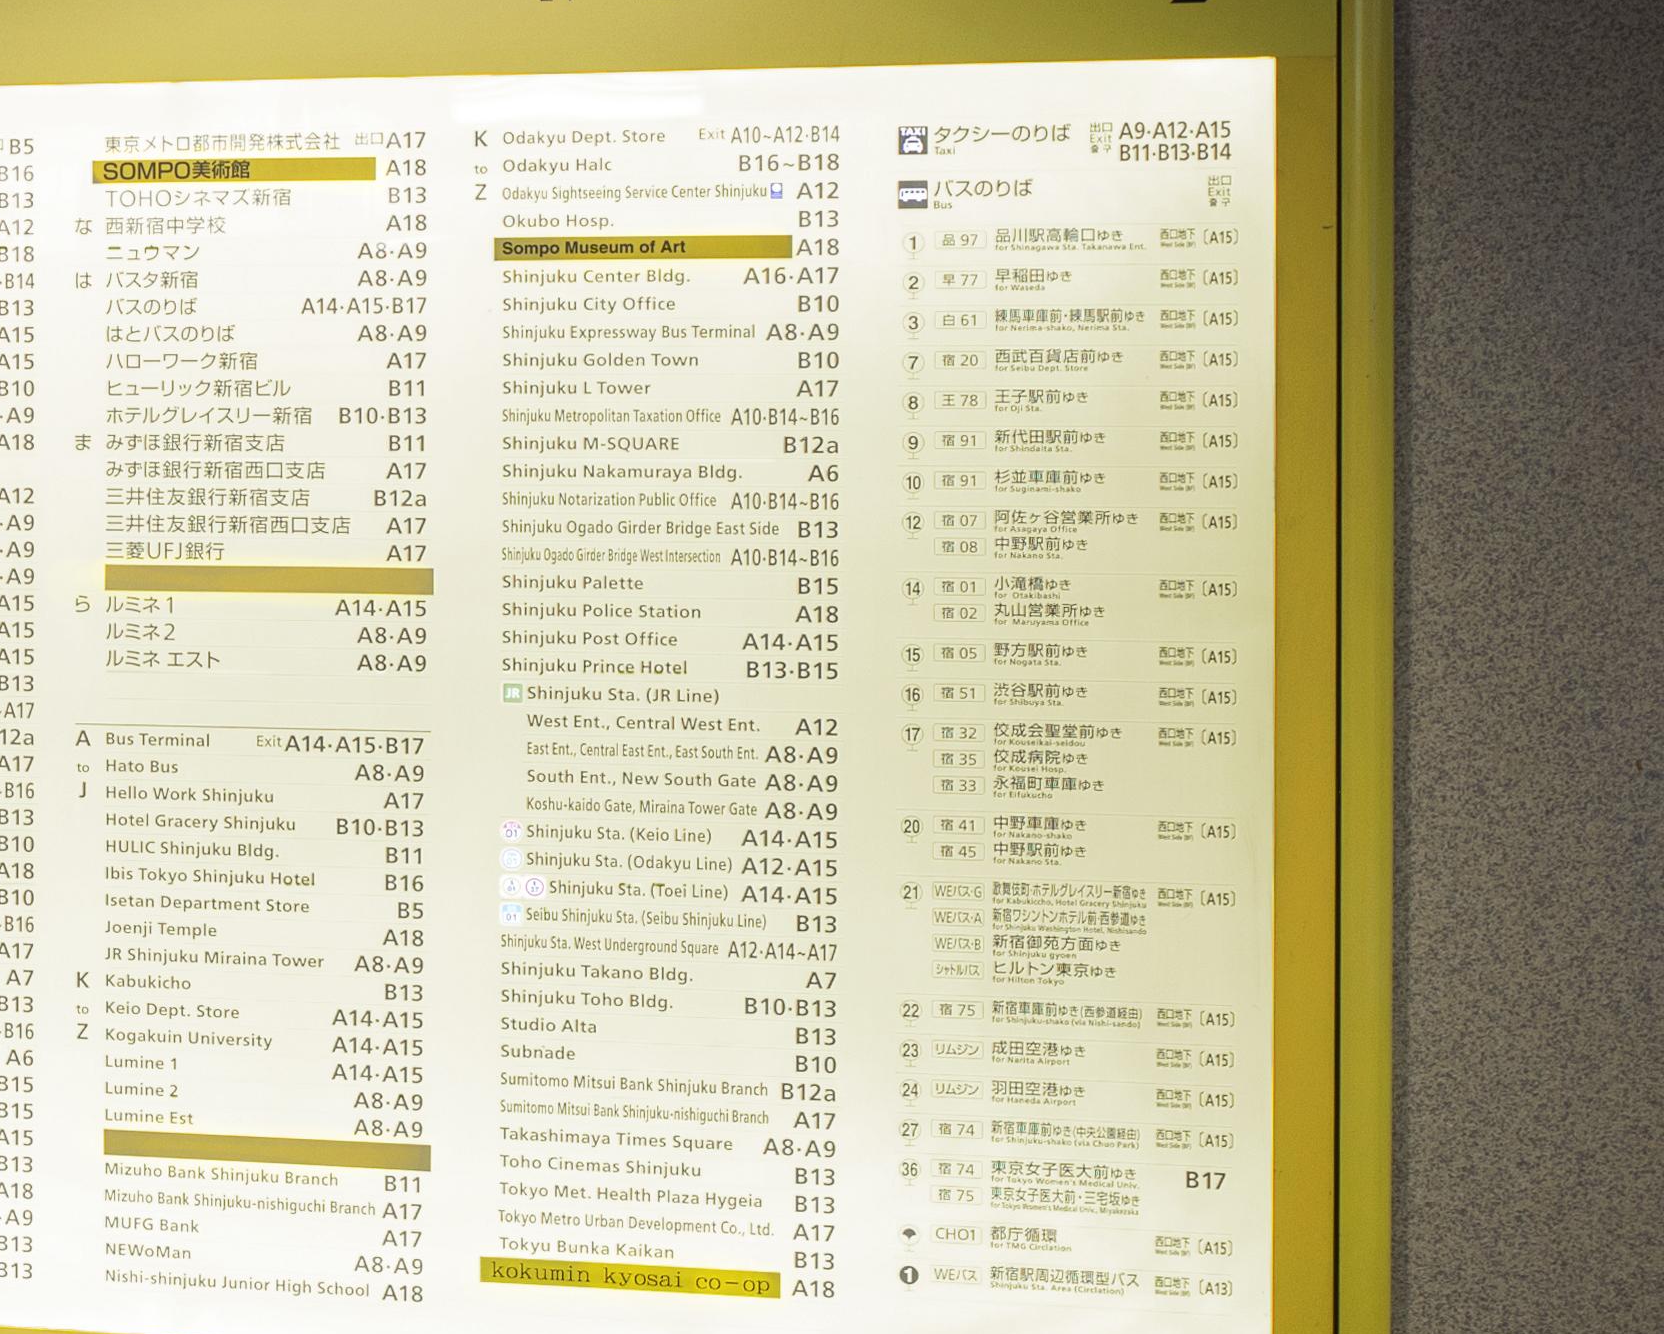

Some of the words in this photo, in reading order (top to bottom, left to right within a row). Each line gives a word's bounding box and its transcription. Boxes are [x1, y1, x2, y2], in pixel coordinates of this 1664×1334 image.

[935, 124, 1071, 143] タクシーのりば
[10, 139, 33, 154] B5
[935, 146, 955, 155] Taxi
[104, 160, 250, 180] SOMPO美術館
[386, 159, 426, 176] A18
[389, 187, 426, 203] B13
[934, 179, 1032, 197] バスのりば
[105, 189, 291, 207] TOHOシネマズ新宿
[934, 201, 952, 209] Bus
[503, 242, 559, 257] Sompo
[565, 241, 633, 254] Museum
[640, 240, 655, 253] of
[661, 241, 685, 253] Art
[796, 239, 839, 255] A18
[503, 297, 576, 314] Shinjuku
[584, 297, 616, 314] City
[623, 297, 675, 310] Office
[799, 295, 839, 312] B10
[107, 407, 312, 425] ホテルグレイスリー新宿
[106, 786, 147, 799] Hello
[153, 788, 196, 800] Work
[203, 788, 273, 805] Shinjuku
[384, 792, 423, 809] A17
[105, 1109, 164, 1123] Lumine
[170, 1112, 193, 1124] Est
[1187, 1171, 1225, 1189] B17
[105, 1216, 153, 1230] MUFG
[160, 1219, 198, 1232] Bank
[382, 1230, 421, 1247] A17
[493, 1261, 590, 1282] kokumin
[605, 1267, 681, 1287] kyosai
[696, 1278, 770, 1294] co-op
[792, 1280, 834, 1298] A18
